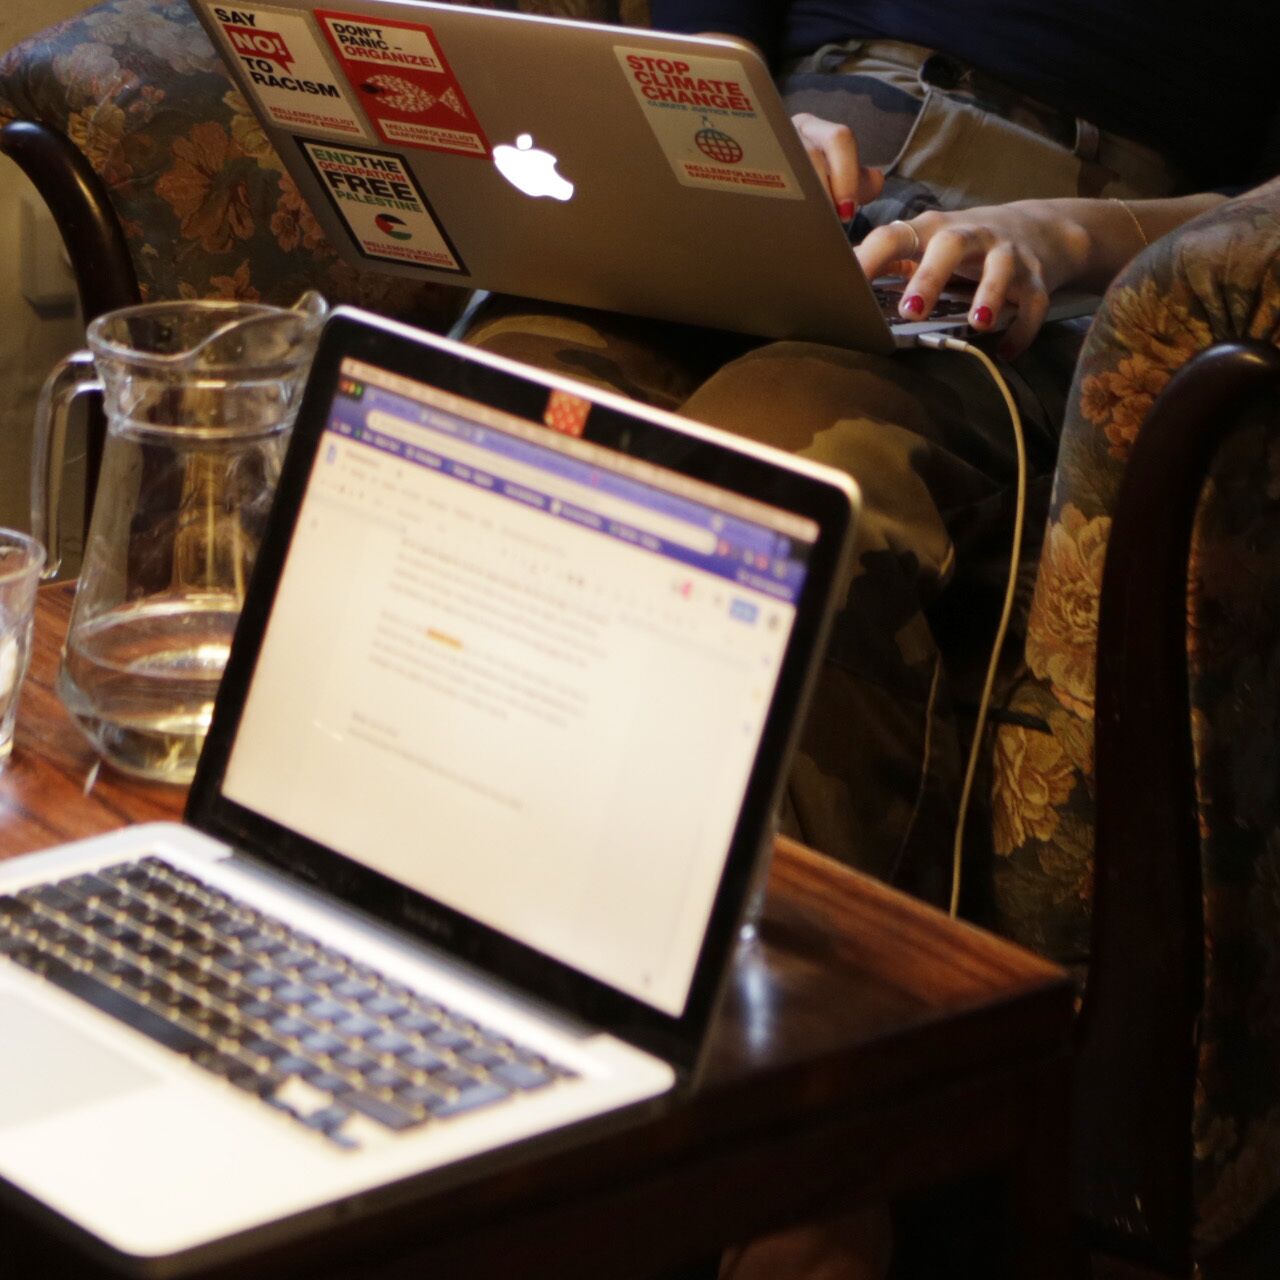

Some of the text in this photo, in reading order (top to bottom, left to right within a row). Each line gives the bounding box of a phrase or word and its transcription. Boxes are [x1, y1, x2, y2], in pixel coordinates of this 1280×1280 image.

[214, 8, 256, 27] SAY
[332, 22, 383, 39] DON'T
[230, 31, 287, 56] NO!
[338, 35, 389, 51] PANIC
[240, 57, 274, 73] TO
[344, 46, 437, 68] ORGANIZE!
[626, 55, 690, 76] STOP
[249, 71, 340, 98] RACISM
[634, 71, 744, 97] CLIMATE
[641, 86, 754, 112] CHANGE!
[318, 161, 406, 183] OCCUPATION
[323, 170, 417, 203] FREE
[334, 189, 423, 213] PALESTINE
